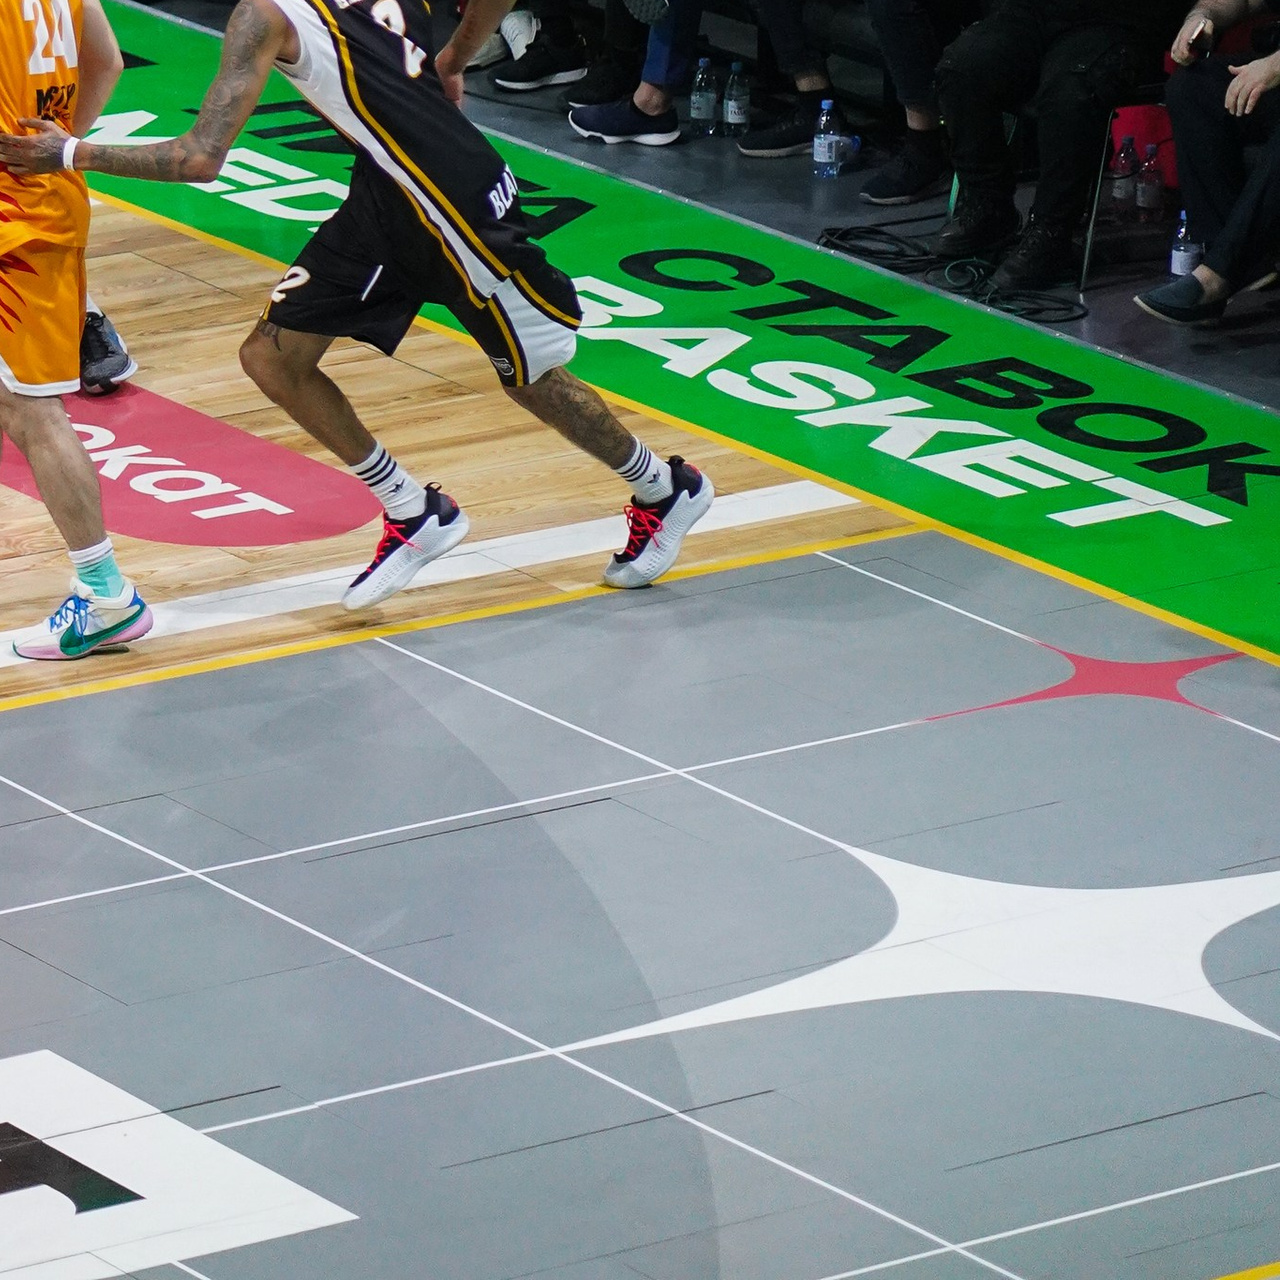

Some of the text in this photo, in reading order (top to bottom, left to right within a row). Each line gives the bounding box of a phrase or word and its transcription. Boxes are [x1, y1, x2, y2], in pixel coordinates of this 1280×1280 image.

[271, 265, 311, 303] 2
[576, 276, 1231, 527] BASKET
[618, 247, 1280, 506] СТАВОК
